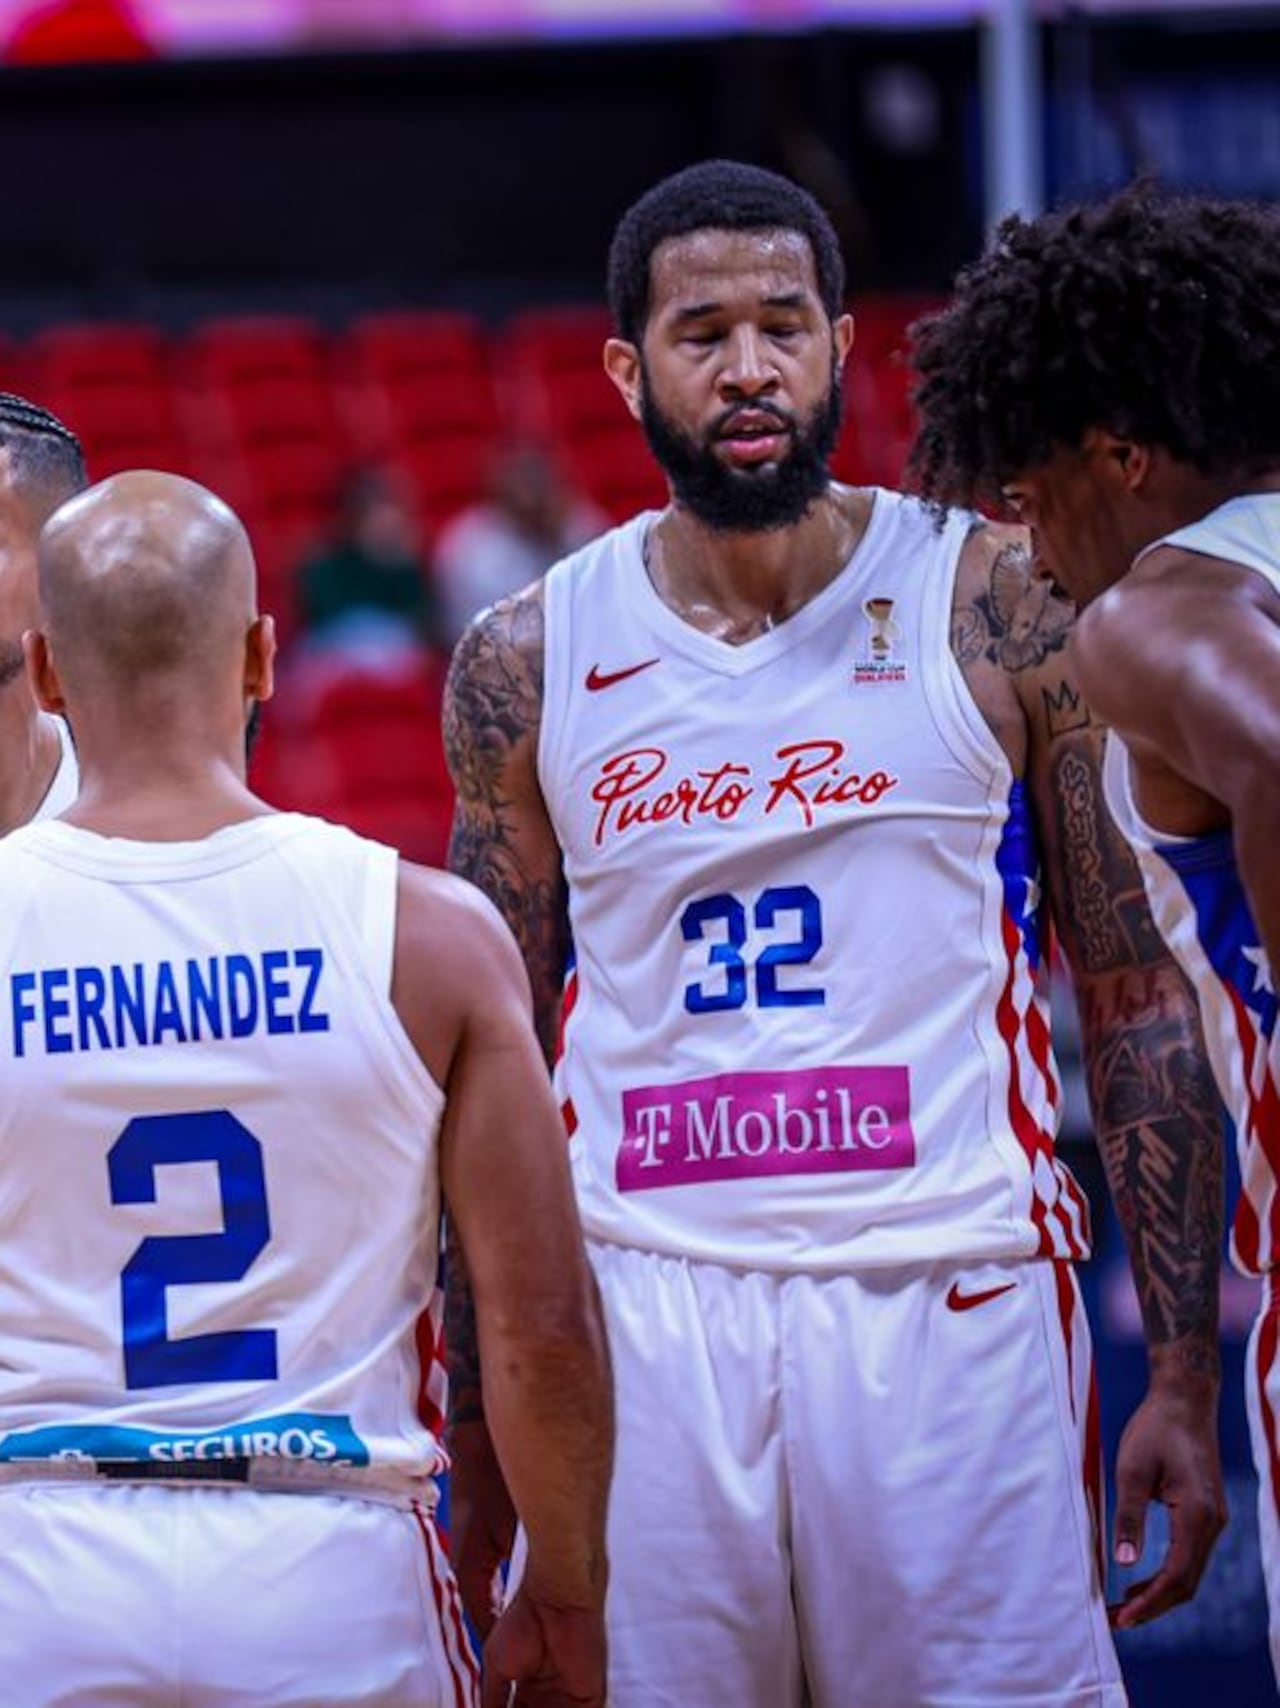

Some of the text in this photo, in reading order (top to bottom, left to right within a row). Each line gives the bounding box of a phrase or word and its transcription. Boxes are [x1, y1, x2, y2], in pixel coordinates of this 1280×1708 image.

[592, 740, 898, 845] Puerto Rico
[11, 948, 330, 1058] FERNANDEZ
[680, 885, 826, 1016] 32
[107, 1109, 279, 1390] 2
